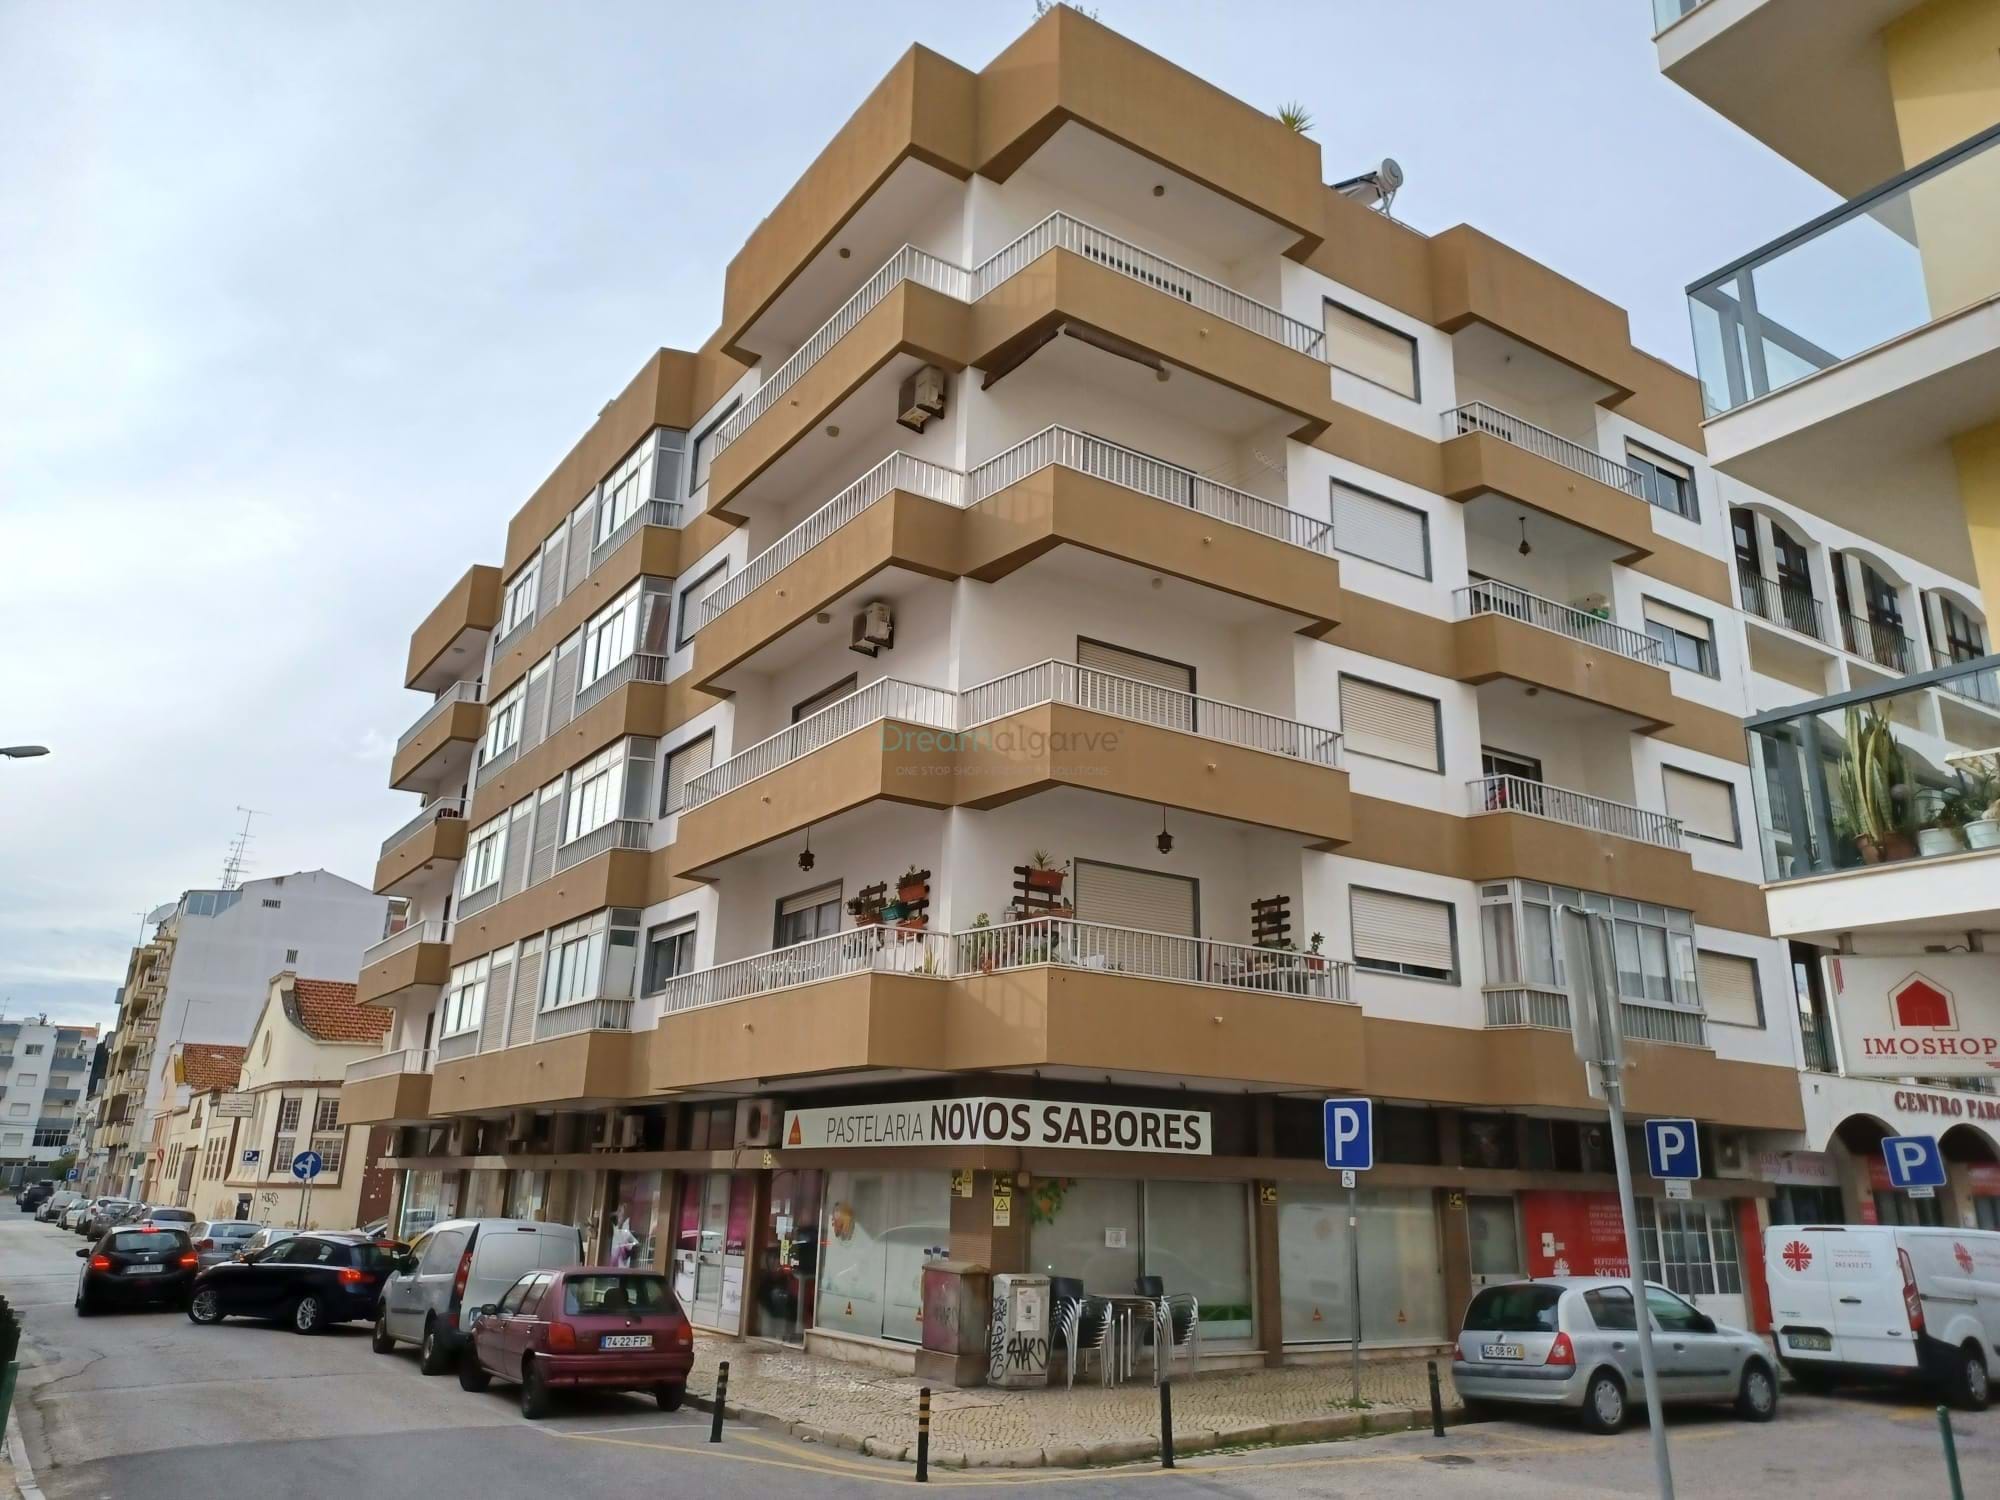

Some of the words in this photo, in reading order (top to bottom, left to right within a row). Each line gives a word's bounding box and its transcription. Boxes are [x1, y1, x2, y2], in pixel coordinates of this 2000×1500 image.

[1863, 1038, 1997, 1054] IMOSHOP
[1894, 1091, 1962, 1116] CENTRO
[826, 1113, 923, 1143] PASTELARIA
[931, 1102, 1030, 1142] NOVOS
[1043, 1106, 1200, 1150] SABORES
[1334, 1107, 1359, 1161] P
[244, 1151, 253, 1161] P
[1657, 1126, 1685, 1171] P
[1894, 1142, 1927, 1181] P
[68, 1169, 77, 1179] P
